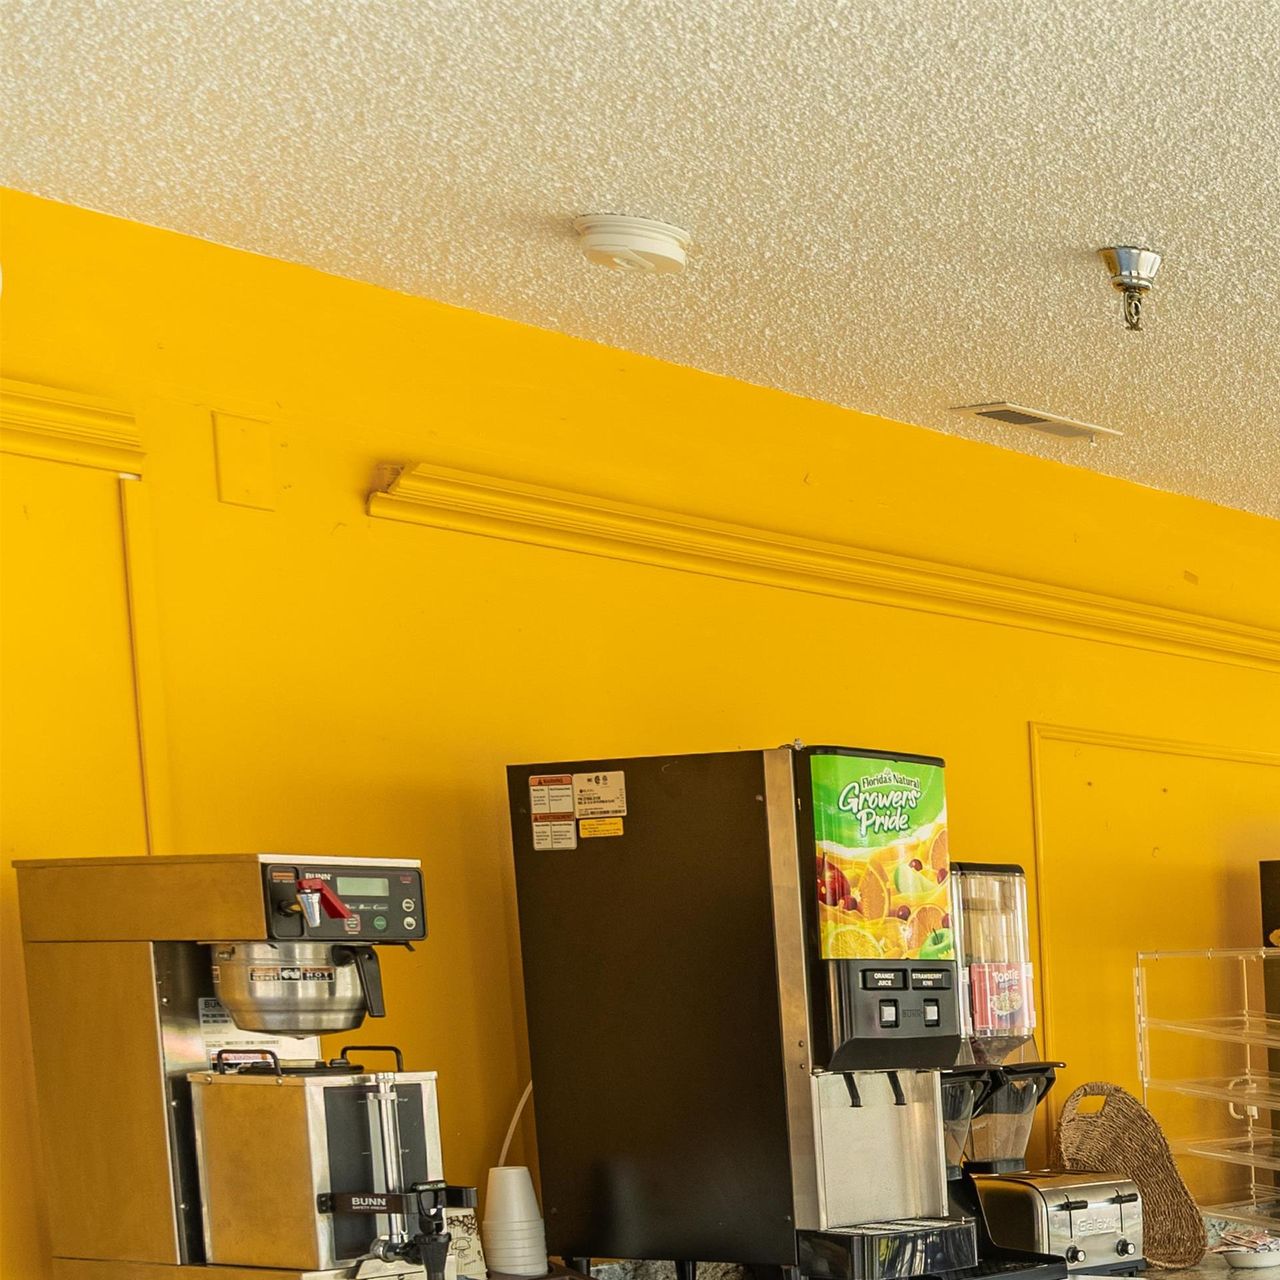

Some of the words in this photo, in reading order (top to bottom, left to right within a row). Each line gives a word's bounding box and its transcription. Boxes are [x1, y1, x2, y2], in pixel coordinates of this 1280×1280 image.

[862, 774, 892, 789] Florida's
[893, 773, 919, 789] Natural
[855, 807, 910, 838] Pride
[352, 1197, 386, 1205] BUNN
